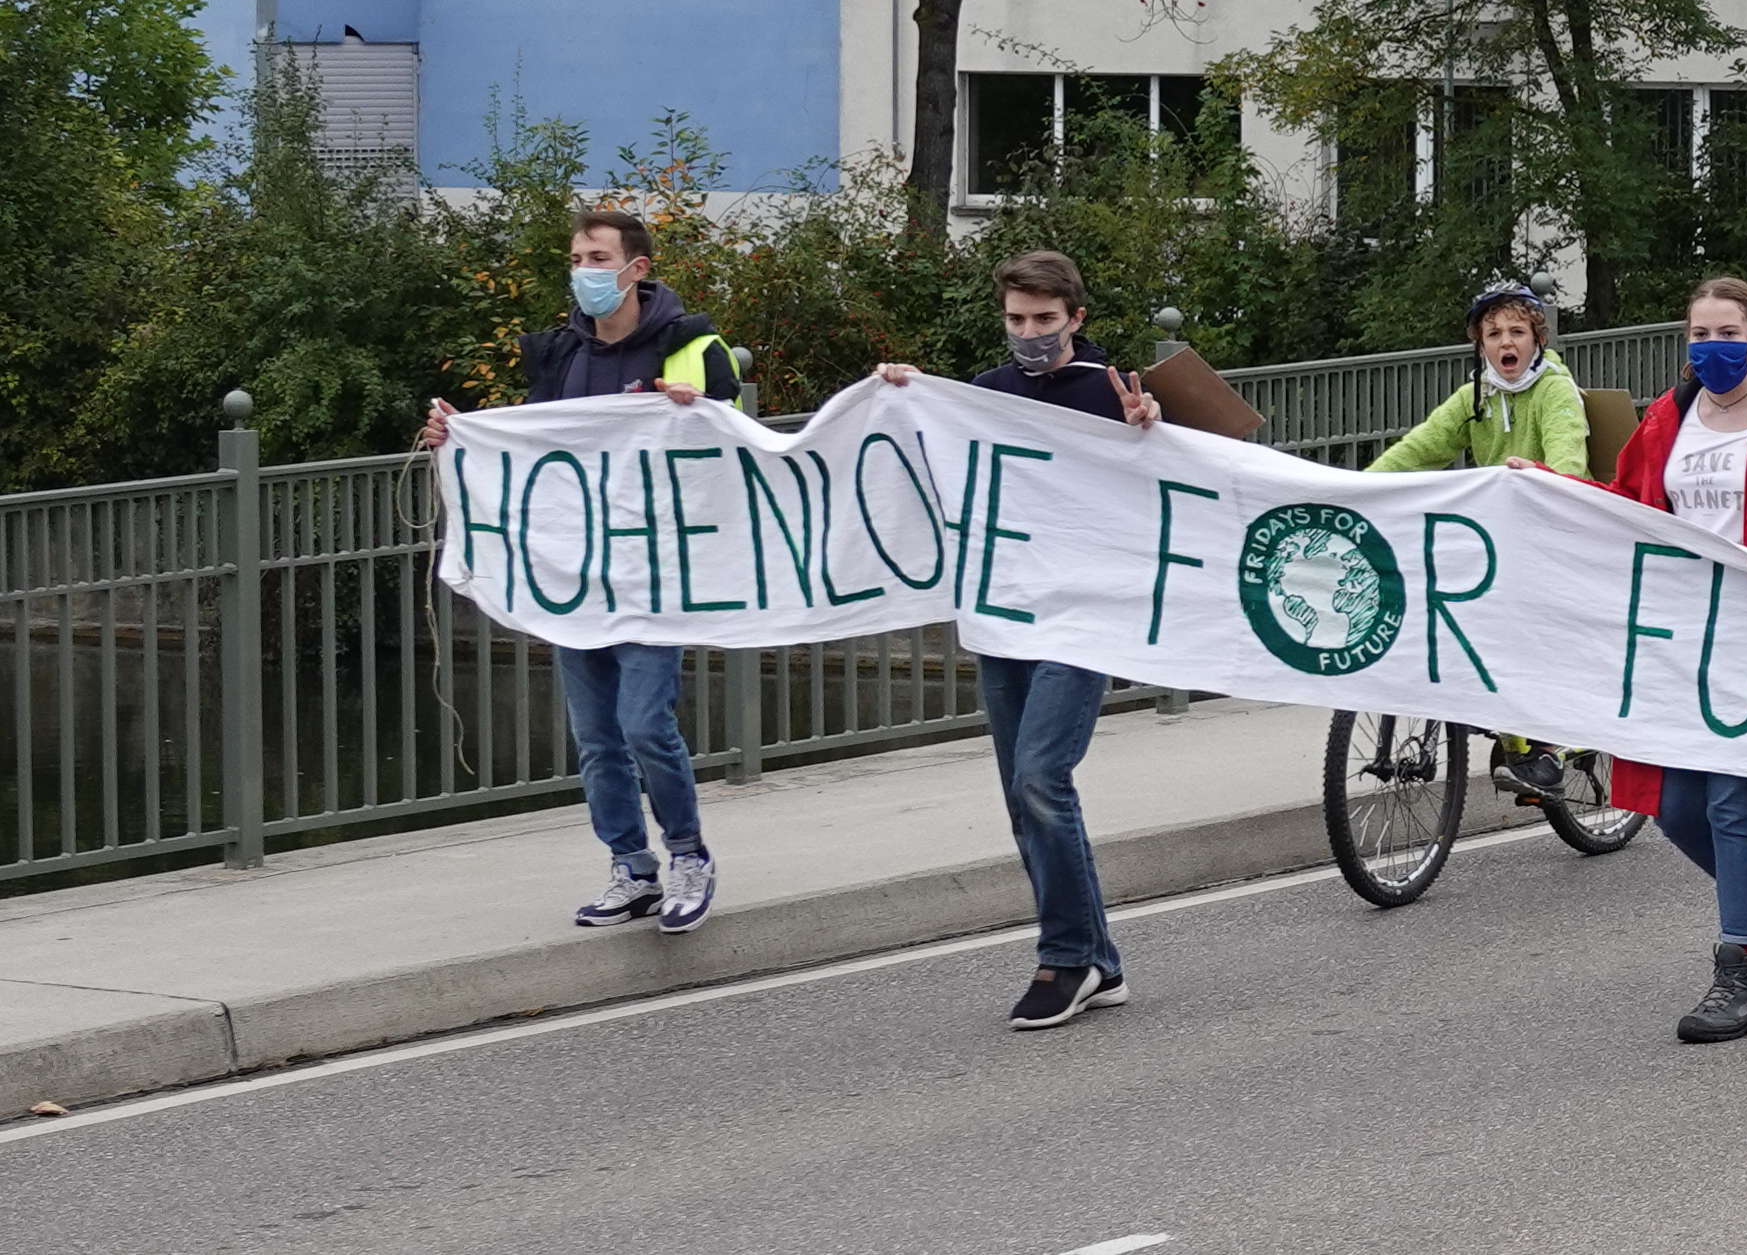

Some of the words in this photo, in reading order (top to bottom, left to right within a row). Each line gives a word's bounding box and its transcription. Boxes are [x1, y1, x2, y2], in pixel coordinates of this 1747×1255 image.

[1682, 452, 1735, 473] SAVE
[1696, 475, 1715, 486] THE
[1669, 489, 1744, 511] PLANET
[454, 430, 1054, 625] HOHENLOHE
[1244, 507, 1311, 585] FRIDAYS
[1319, 508, 1369, 544] FOR
[1318, 610, 1402, 671] FUTURE
